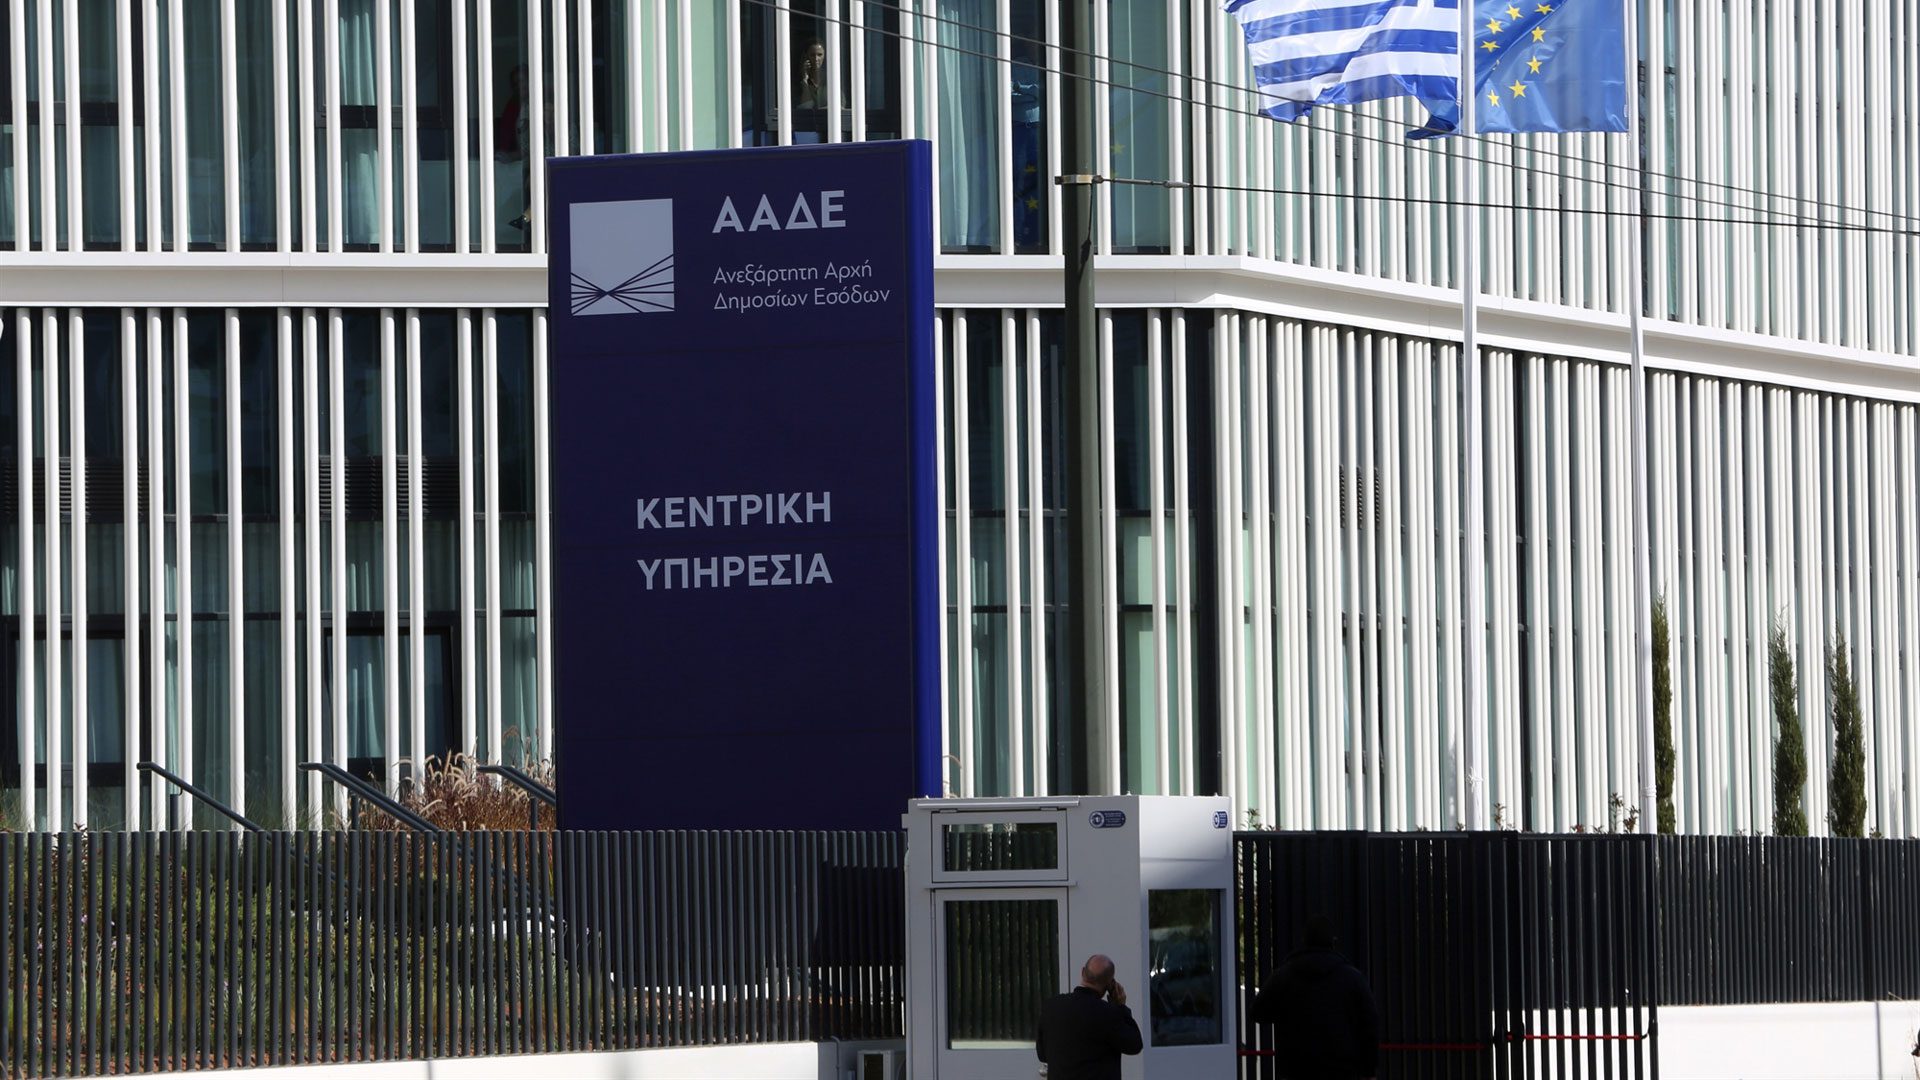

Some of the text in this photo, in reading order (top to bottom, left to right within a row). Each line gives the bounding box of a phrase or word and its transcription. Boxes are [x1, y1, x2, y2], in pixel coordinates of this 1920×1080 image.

[712, 190, 846, 233] ΑΑΔΕ
[713, 259, 872, 286] Ανεξάρτητη Αρχή
[713, 285, 890, 313] Δημοσίων Εσόδων
[637, 491, 831, 529] ΚΕΝΤΡΙΚΗ
[637, 553, 832, 590] ΥΠΗΡΕΣΙΑ
